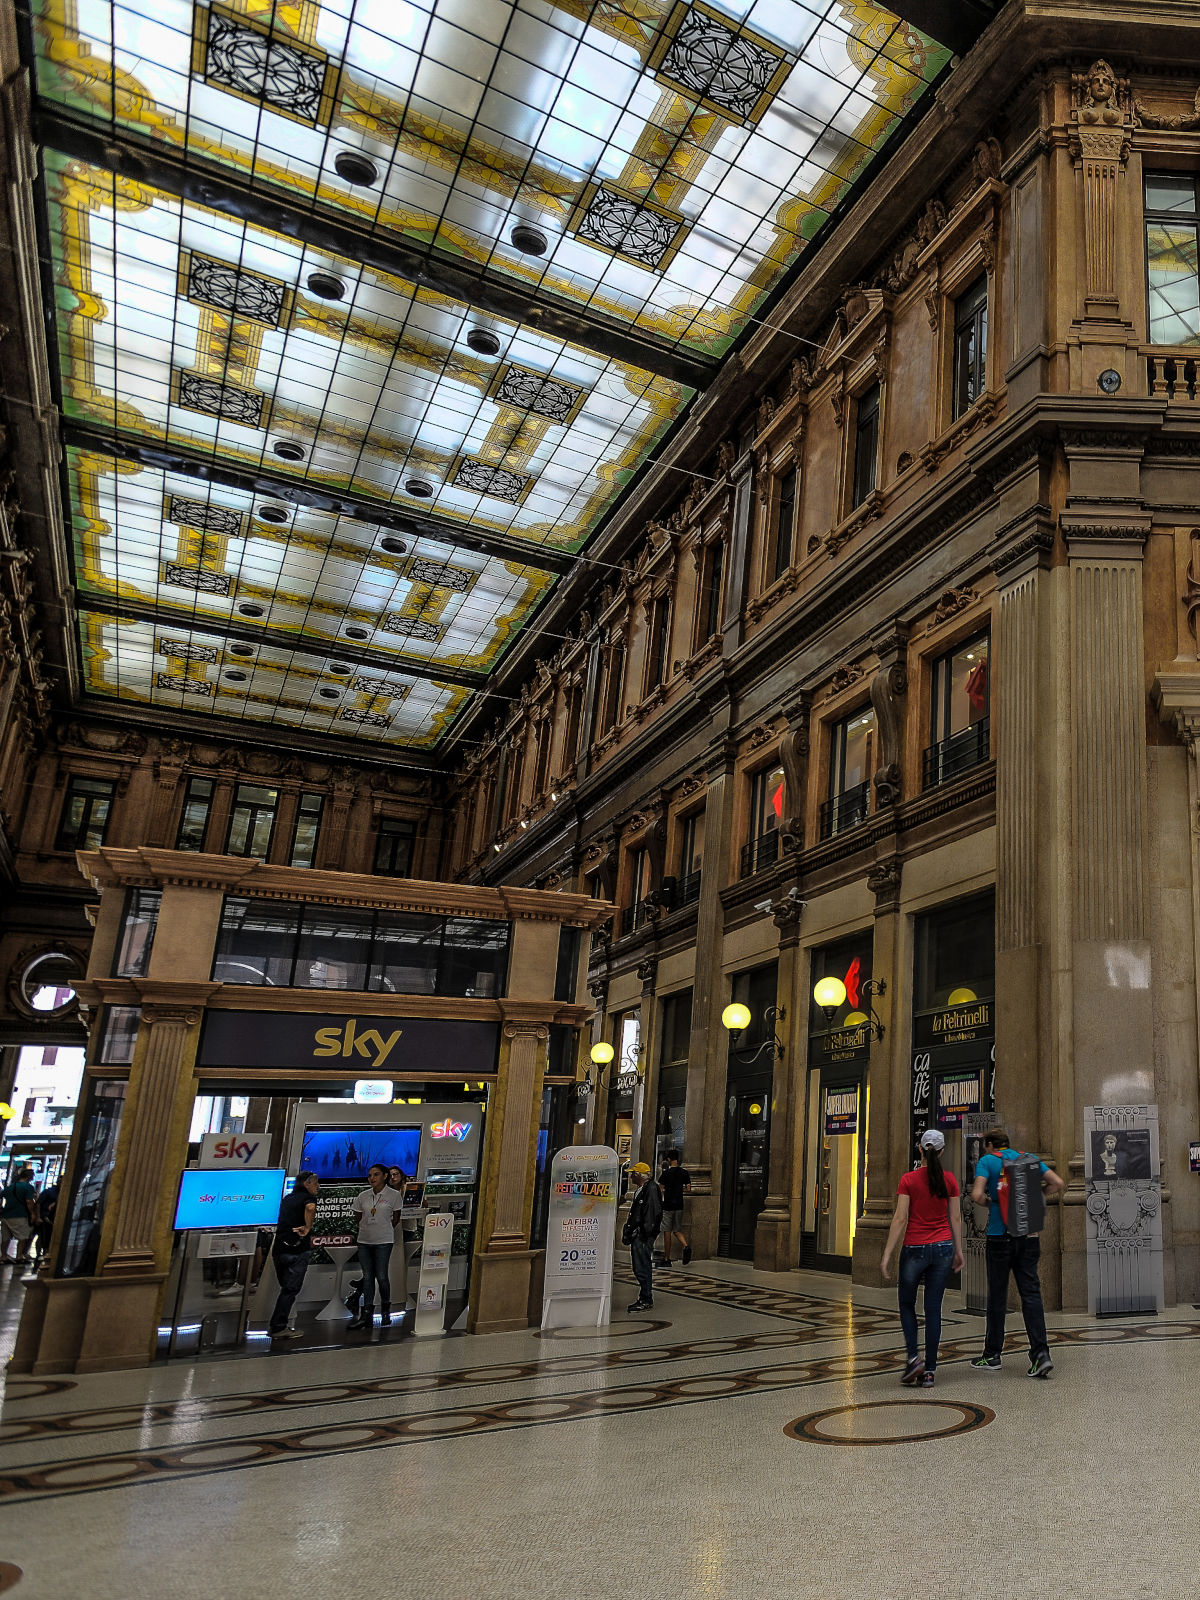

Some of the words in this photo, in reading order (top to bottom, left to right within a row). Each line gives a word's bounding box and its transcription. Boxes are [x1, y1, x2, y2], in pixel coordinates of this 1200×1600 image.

[932, 1015, 942, 1032] la
[943, 1005, 989, 1031] Feltrinelli
[313, 1019, 402, 1067] sky
[430, 1118, 472, 1142] sky
[213, 1136, 259, 1163] sky
[199, 1194, 216, 1203] sky
[428, 1217, 450, 1228] sky
[312, 1236, 351, 1245] CALCIO
[561, 1250, 579, 1262] 20
